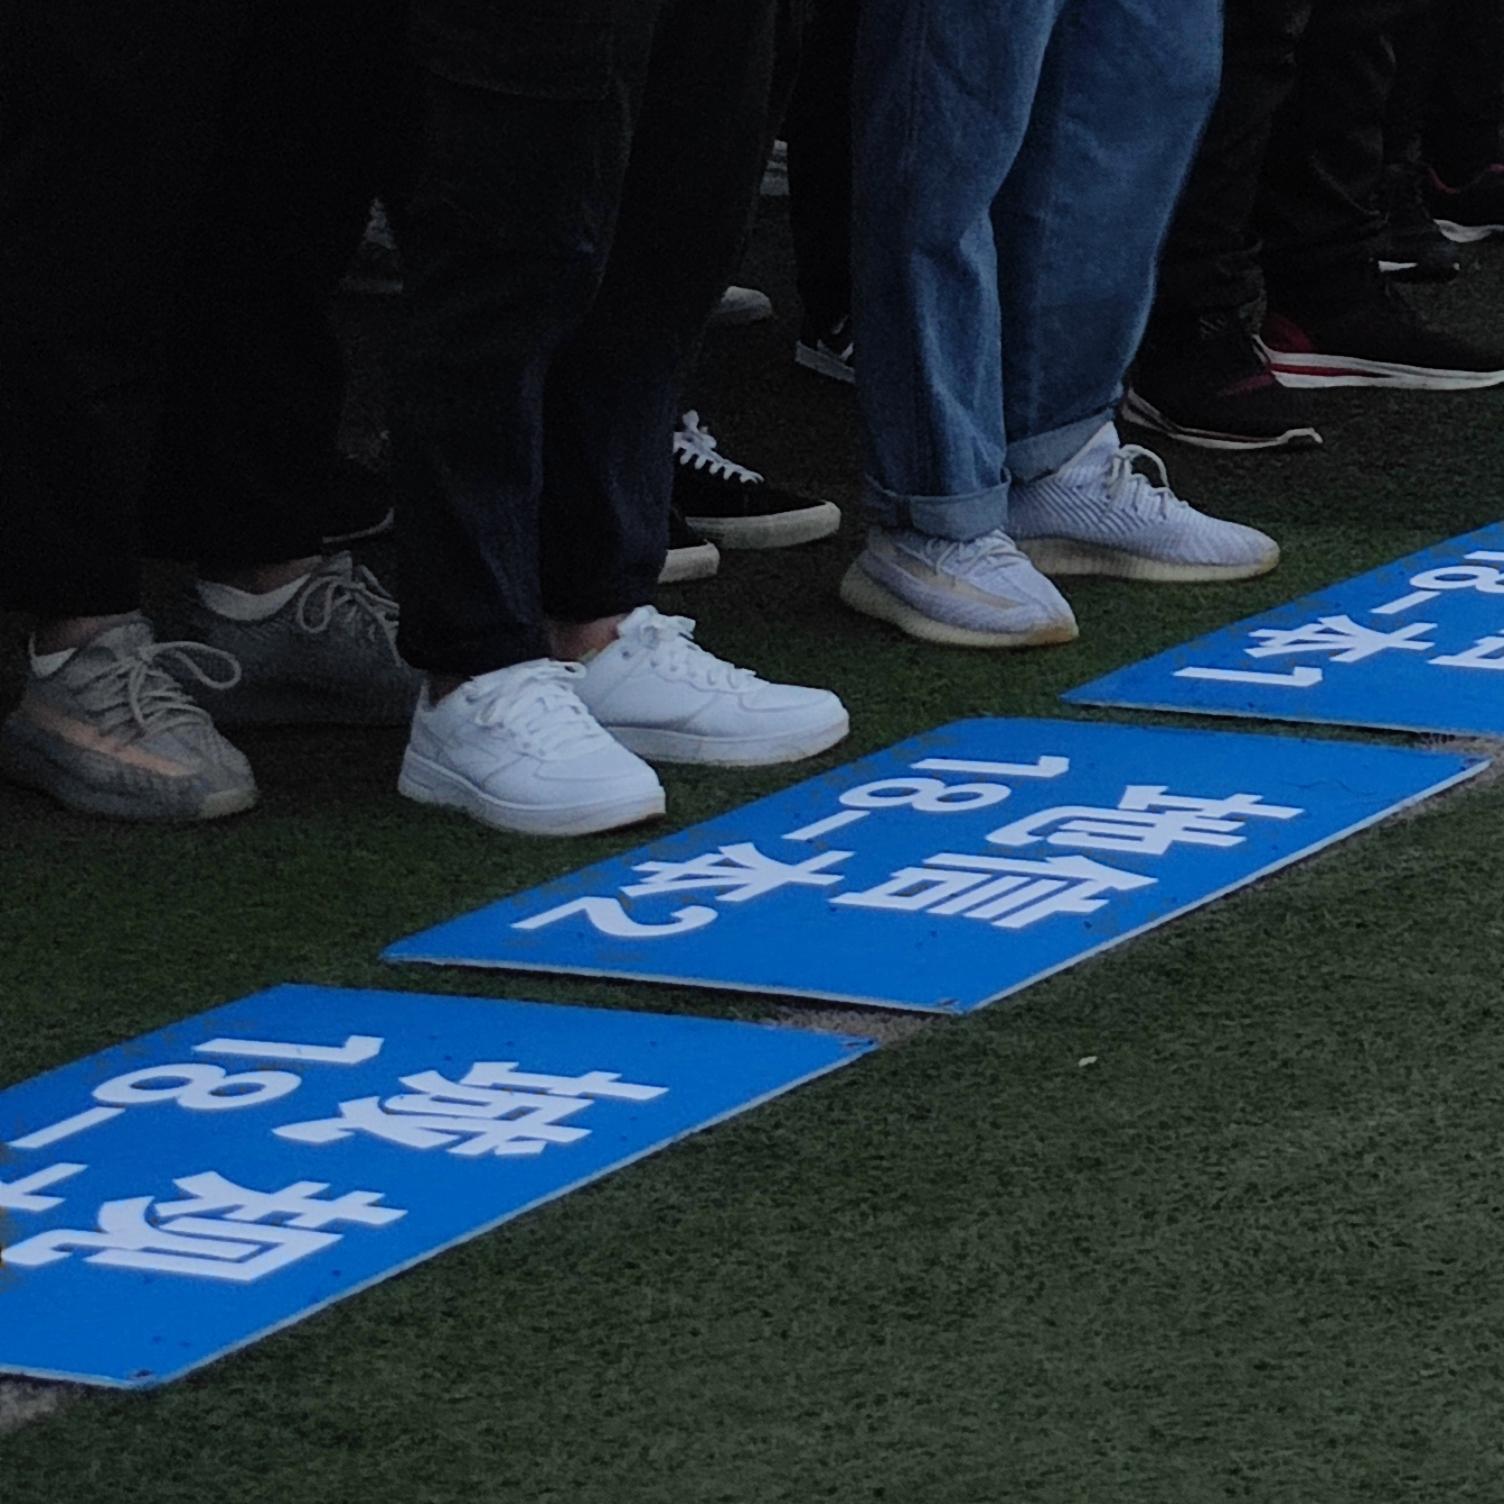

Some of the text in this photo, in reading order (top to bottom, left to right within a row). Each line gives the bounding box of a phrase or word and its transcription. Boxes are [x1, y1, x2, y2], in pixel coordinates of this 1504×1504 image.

[510, 754, 1072, 940] 18-本2
[828, 785, 1306, 930] 地信
[0, 1060, 670, 1283] 城规
